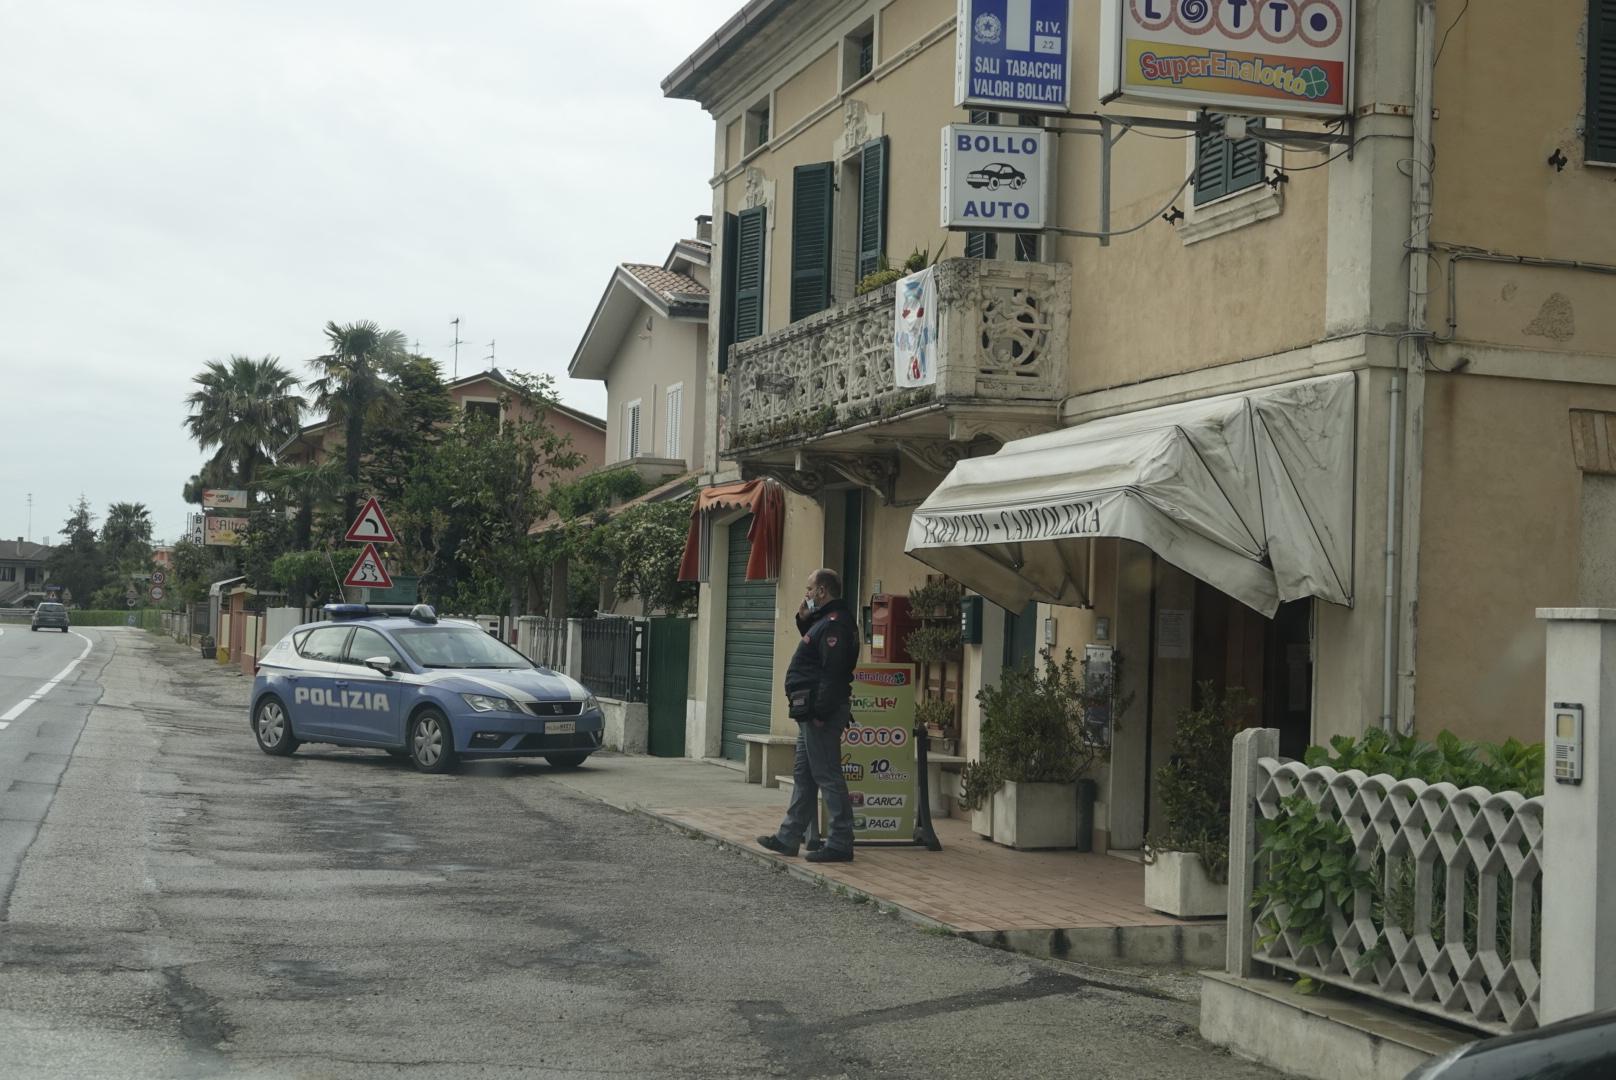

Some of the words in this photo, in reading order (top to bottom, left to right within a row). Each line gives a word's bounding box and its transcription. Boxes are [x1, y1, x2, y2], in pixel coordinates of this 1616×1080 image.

[1036, 20, 1061, 34] RIV.
[1042, 41, 1055, 50] 22
[974, 56, 1000, 74] SALI
[1006, 59, 1062, 80] TABACCHI
[1140, 50, 1307, 97] SuperEnalotto
[973, 78, 1014, 98] VALORI
[1017, 82, 1062, 102] BOLLATI
[957, 134, 1038, 156] BOLLO
[962, 201, 1031, 219] AUTO
[925, 514, 989, 544] TABACCHI
[1001, 503, 1100, 540] CARTOLERIA
[294, 686, 390, 712] POLIZIA
[843, 728, 906, 746] OTTO
[870, 759, 889, 774] 10
[866, 796, 903, 806] CARICA
[868, 819, 897, 828] PAGA
